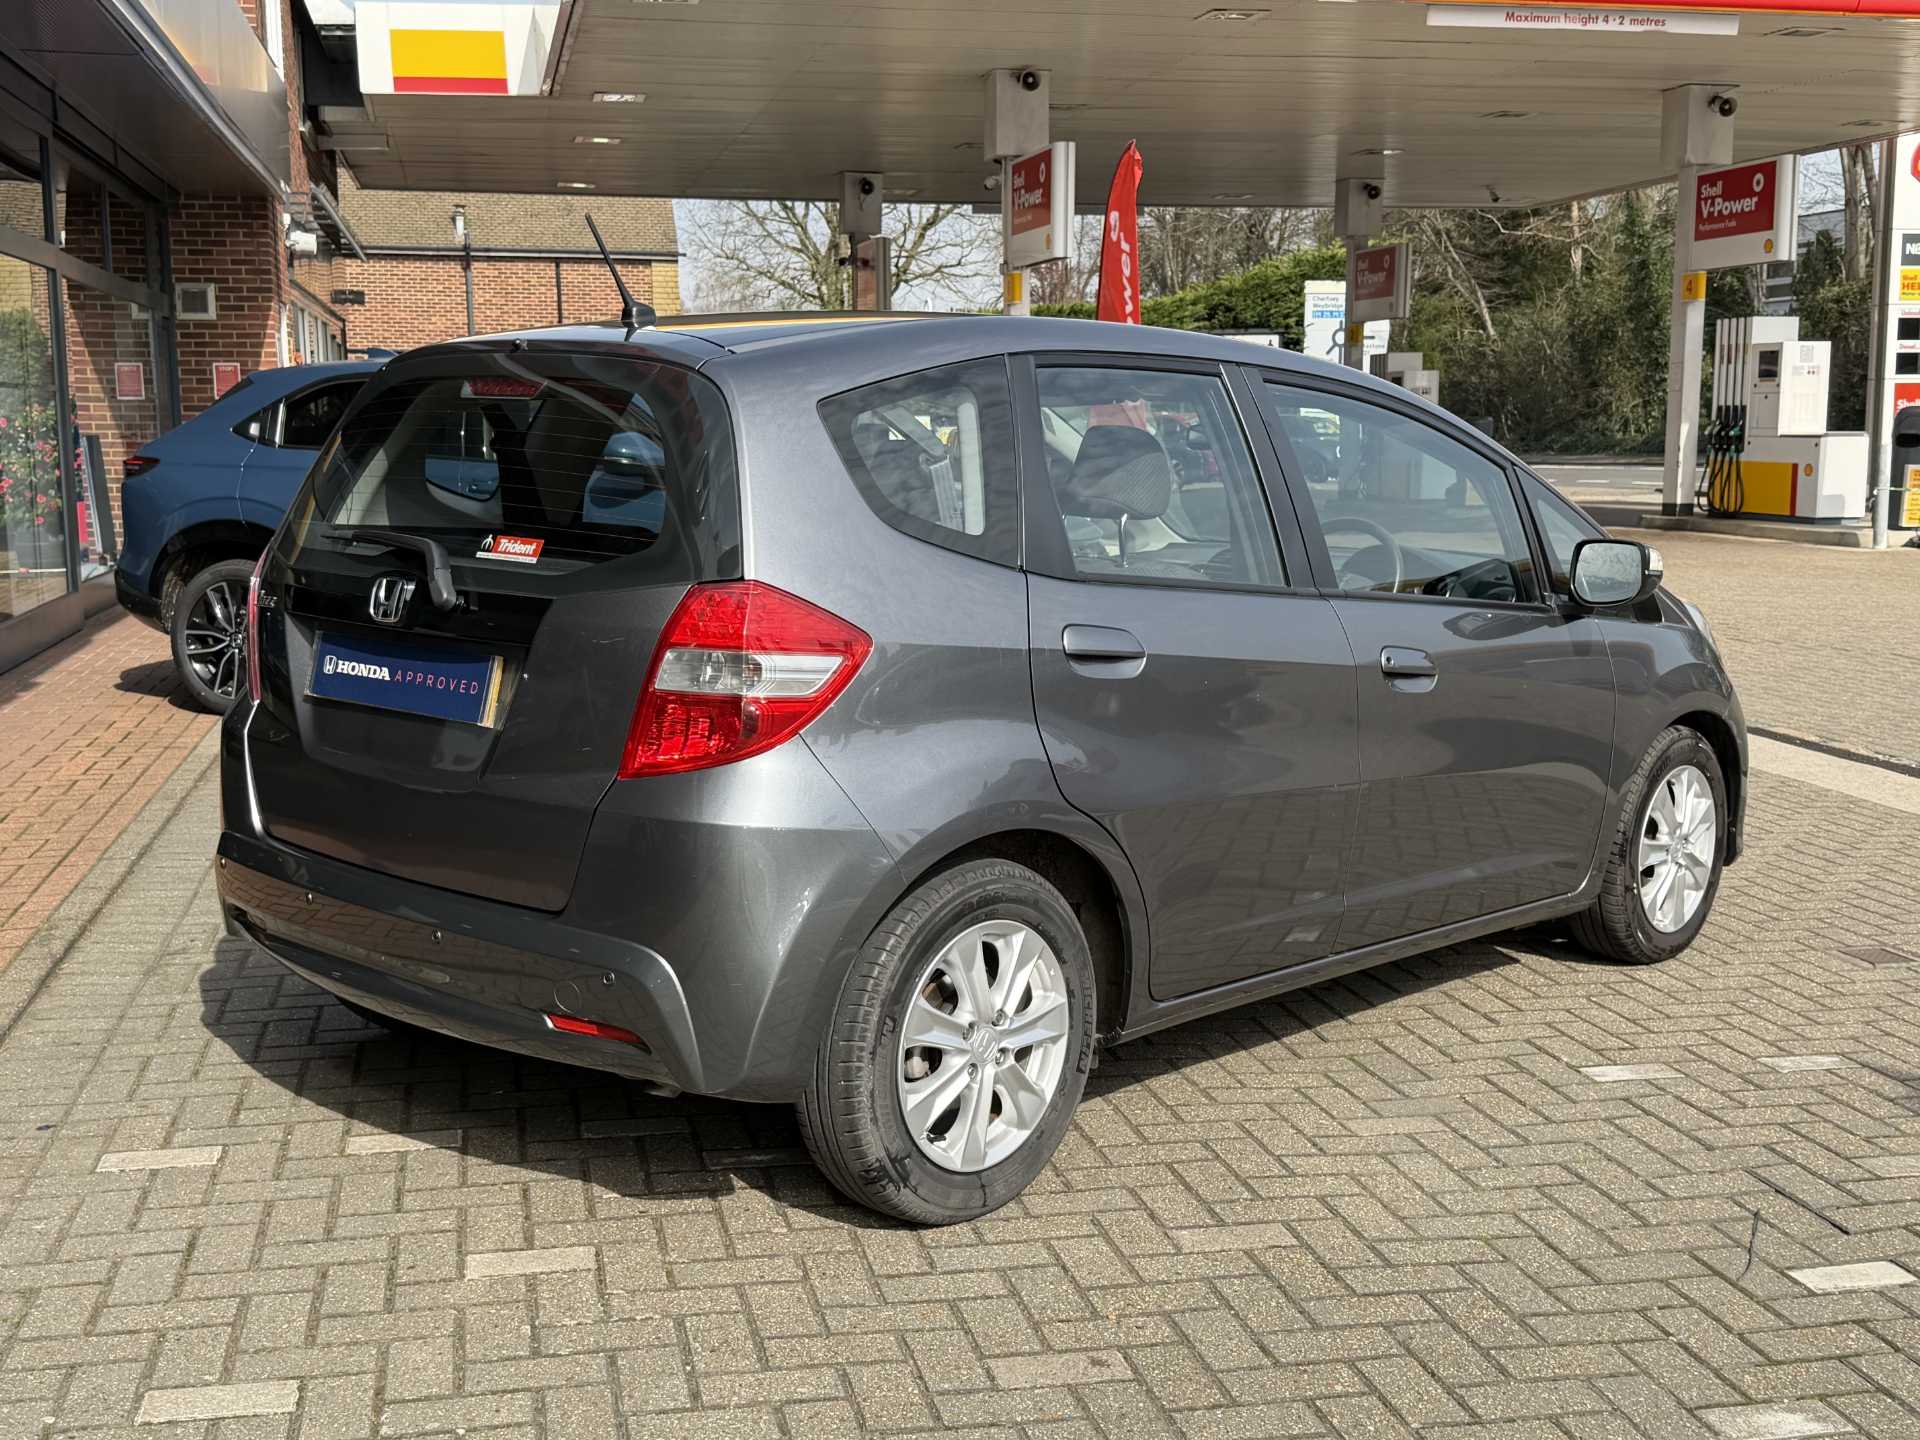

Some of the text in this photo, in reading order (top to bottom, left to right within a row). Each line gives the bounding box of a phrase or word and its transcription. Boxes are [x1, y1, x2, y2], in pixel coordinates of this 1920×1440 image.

[1504, 11, 1561, 24] Maximum
[1564, 13, 1599, 26] height
[1629, 17, 1667, 27] metres
[1013, 188, 1043, 210] V-Power
[1701, 181, 1722, 198] Shell
[1701, 196, 1758, 219] V-Power
[498, 539, 537, 555] Trident
[336, 659, 479, 695] HONDA APPROVED
